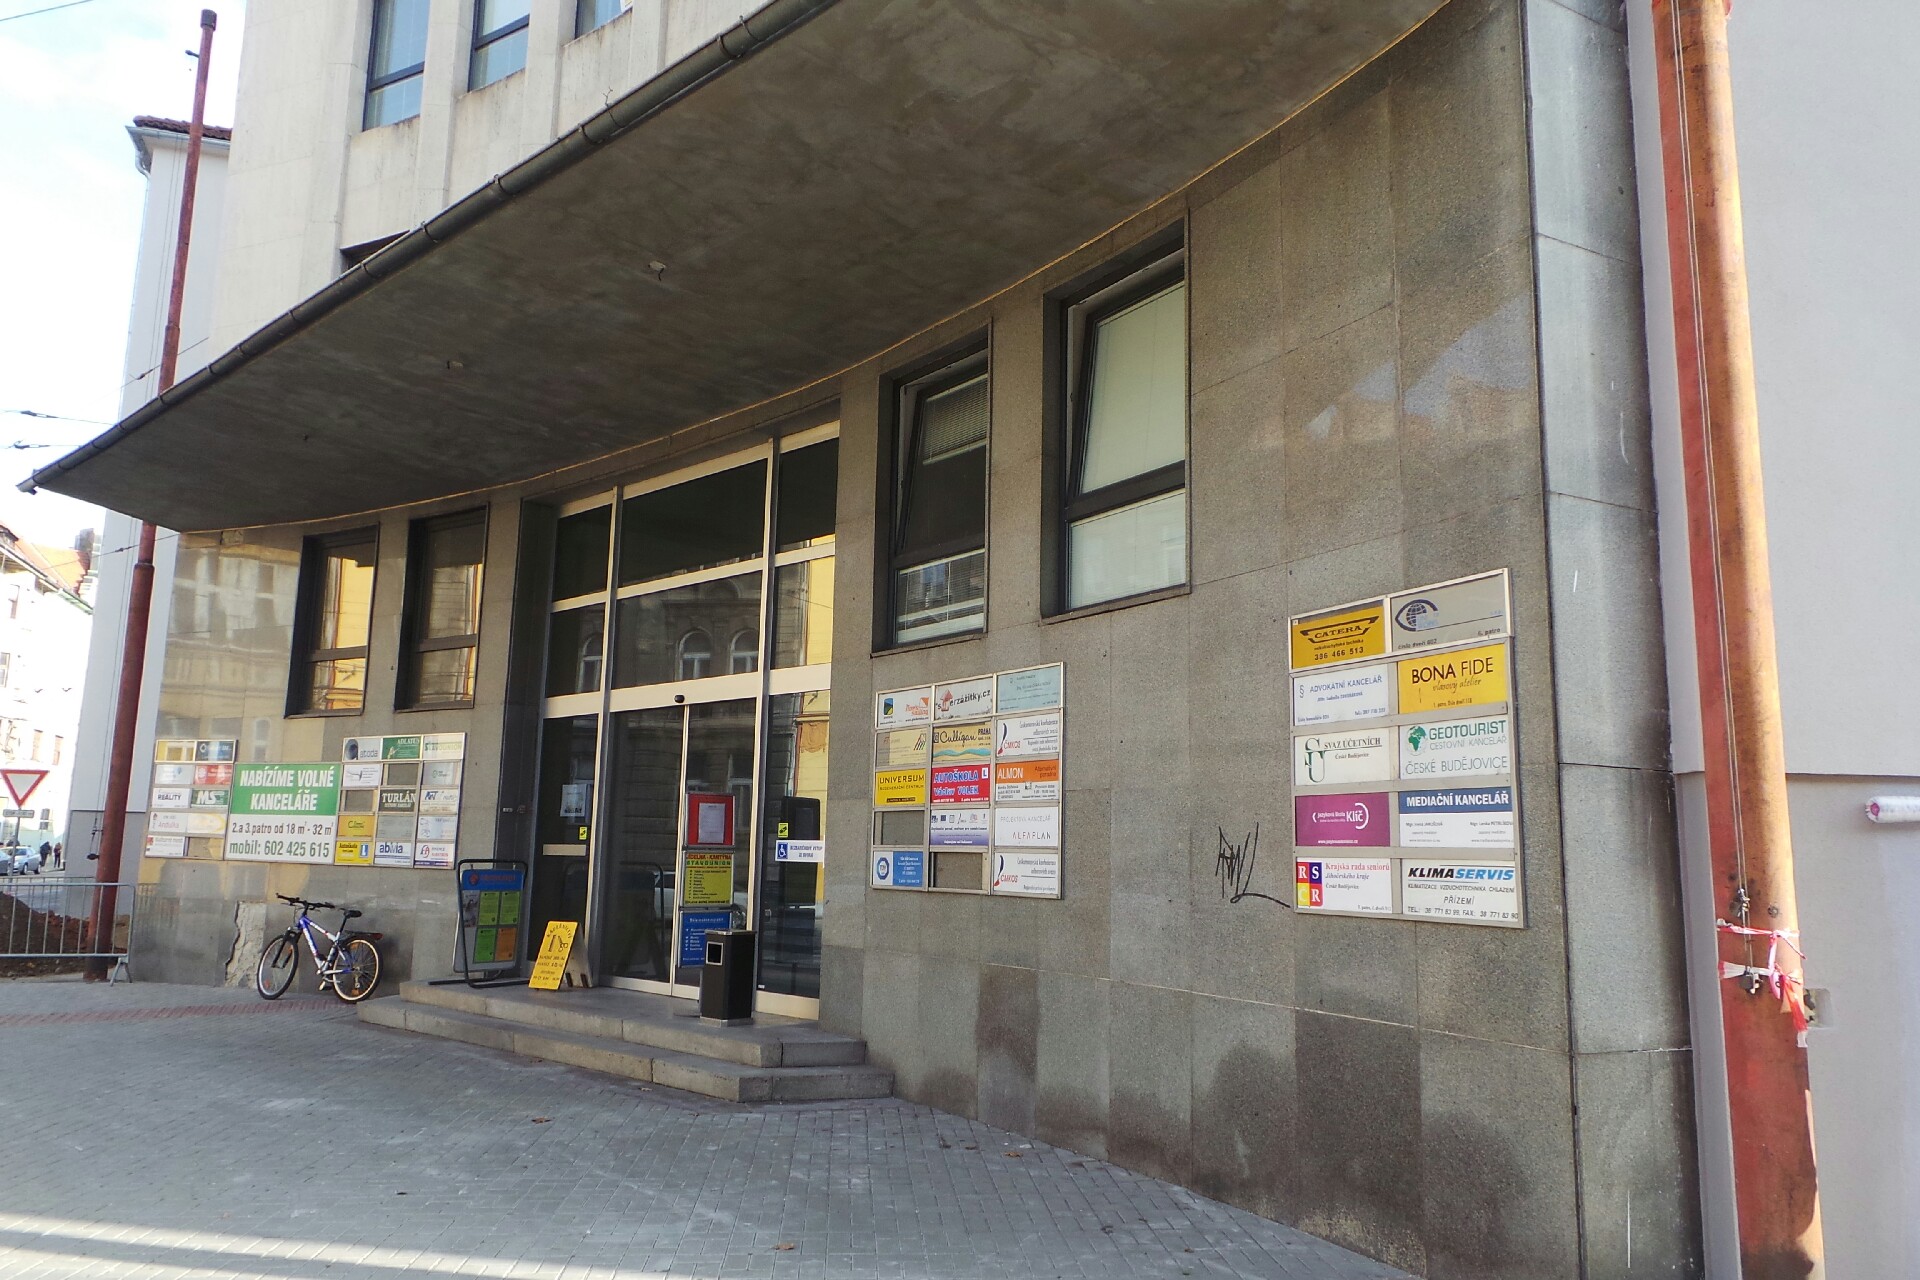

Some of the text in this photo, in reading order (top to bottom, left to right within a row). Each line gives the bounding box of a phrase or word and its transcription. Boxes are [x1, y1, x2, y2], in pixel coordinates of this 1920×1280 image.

[1314, 625, 1363, 639] CATERA
[1349, 646, 1364, 655] 513
[1411, 657, 1494, 684] BONA FIDE
[1429, 719, 1507, 741] GEOTOURIST
[940, 730, 977, 748] Culligan
[1324, 735, 1381, 750] SVAZ ÚČETNÍCH
[1429, 739, 1466, 751] CESTOVNÍ
[1405, 755, 1508, 775] ČESKÉ BUDĚJOVICE
[240, 765, 335, 788] NABÍZÍME VOLNÉ
[879, 774, 925, 784] UNIVERSUM
[933, 768, 979, 783] AUTOŠKOLA
[997, 767, 1024, 780] ALMON
[250, 789, 318, 811] KANCELÁŘE
[381, 790, 417, 803] TURLÁN
[1406, 791, 1509, 807] MEDIAČNÍ KANCELÁŘ
[1346, 810, 1364, 822] Klíč
[274, 823, 283, 834] od
[286, 823, 296, 835] 18
[312, 824, 323, 836] 32
[1012, 831, 1051, 840] ALFAPLAN
[229, 839, 330, 858] mobil: 602 425 615
[1351, 862, 1366, 871] rada
[1366, 862, 1390, 871] seniorů
[1408, 867, 1514, 881] KLIMASERVIS
[1440, 884, 1487, 892] VZDUCHOTECHNIKA
[1443, 895, 1476, 906] PŘÍZEMÍ
[1489, 911, 1500, 919] 771
